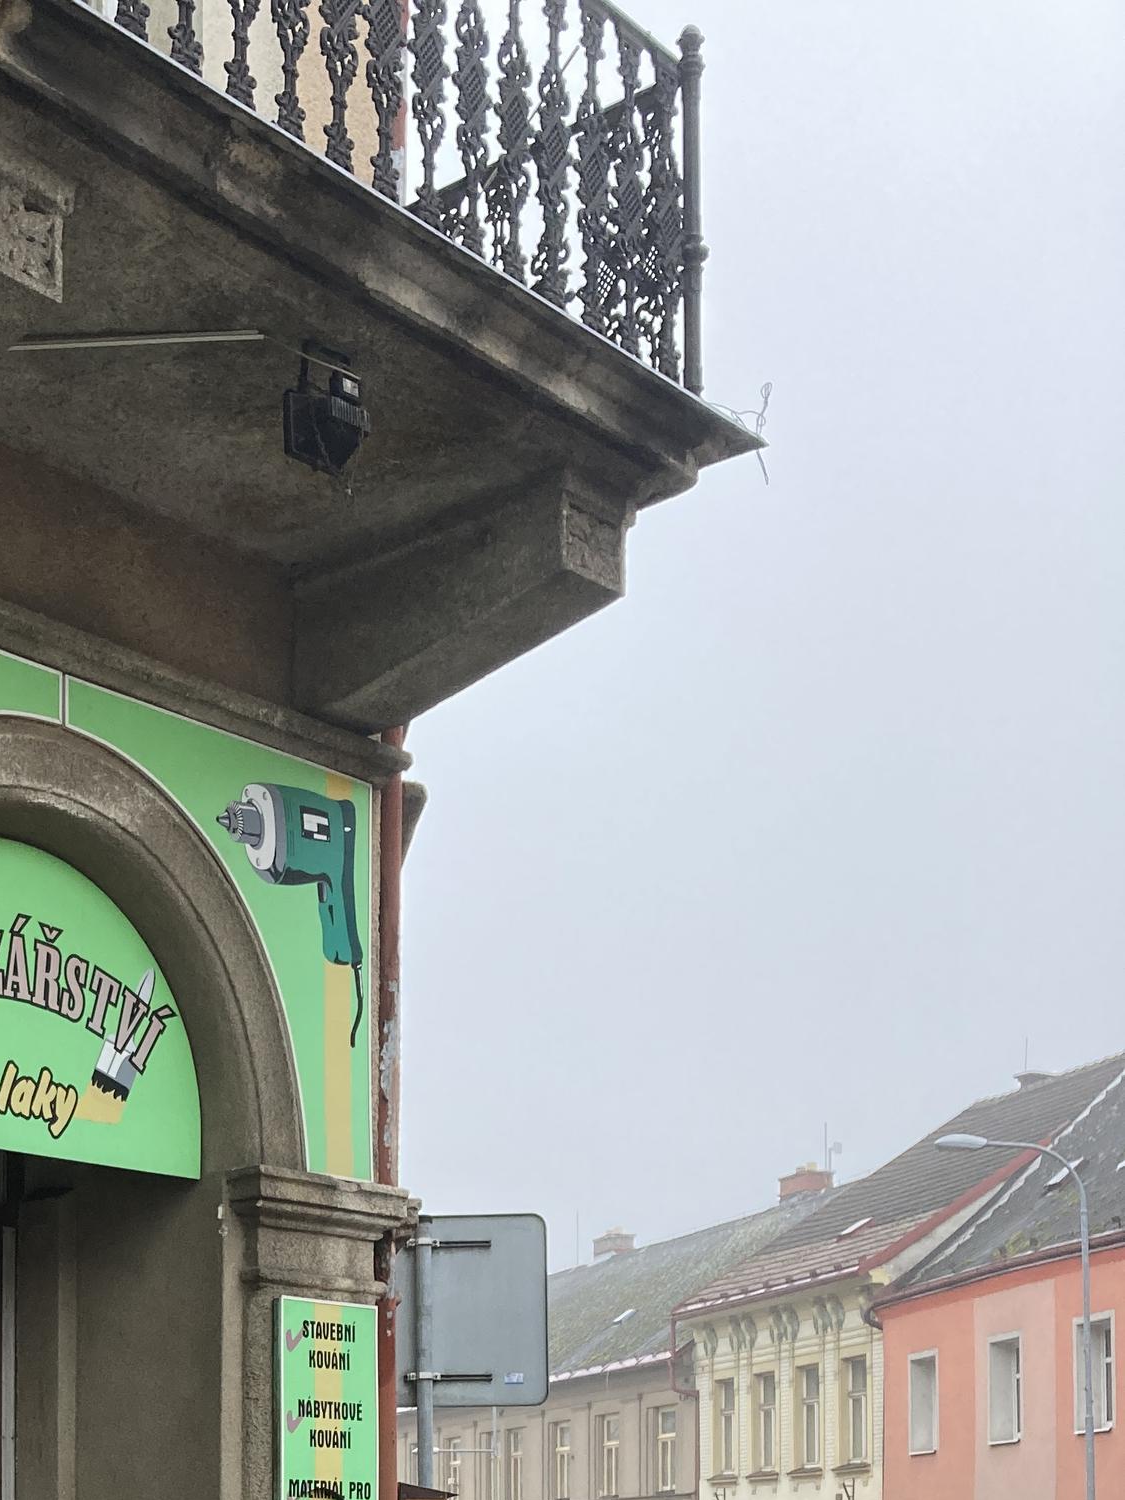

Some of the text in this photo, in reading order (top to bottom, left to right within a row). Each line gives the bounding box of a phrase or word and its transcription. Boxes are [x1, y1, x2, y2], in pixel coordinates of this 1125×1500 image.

[302, 1319, 356, 1343] STAVEBNÍ
[308, 1349, 351, 1371] KOVÁNÍ
[297, 1396, 363, 1422] NÁBYTKOVÉ
[309, 1427, 352, 1449] KOVÁNÍ
[288, 1476, 371, 1500] MATERIÁL PRO
